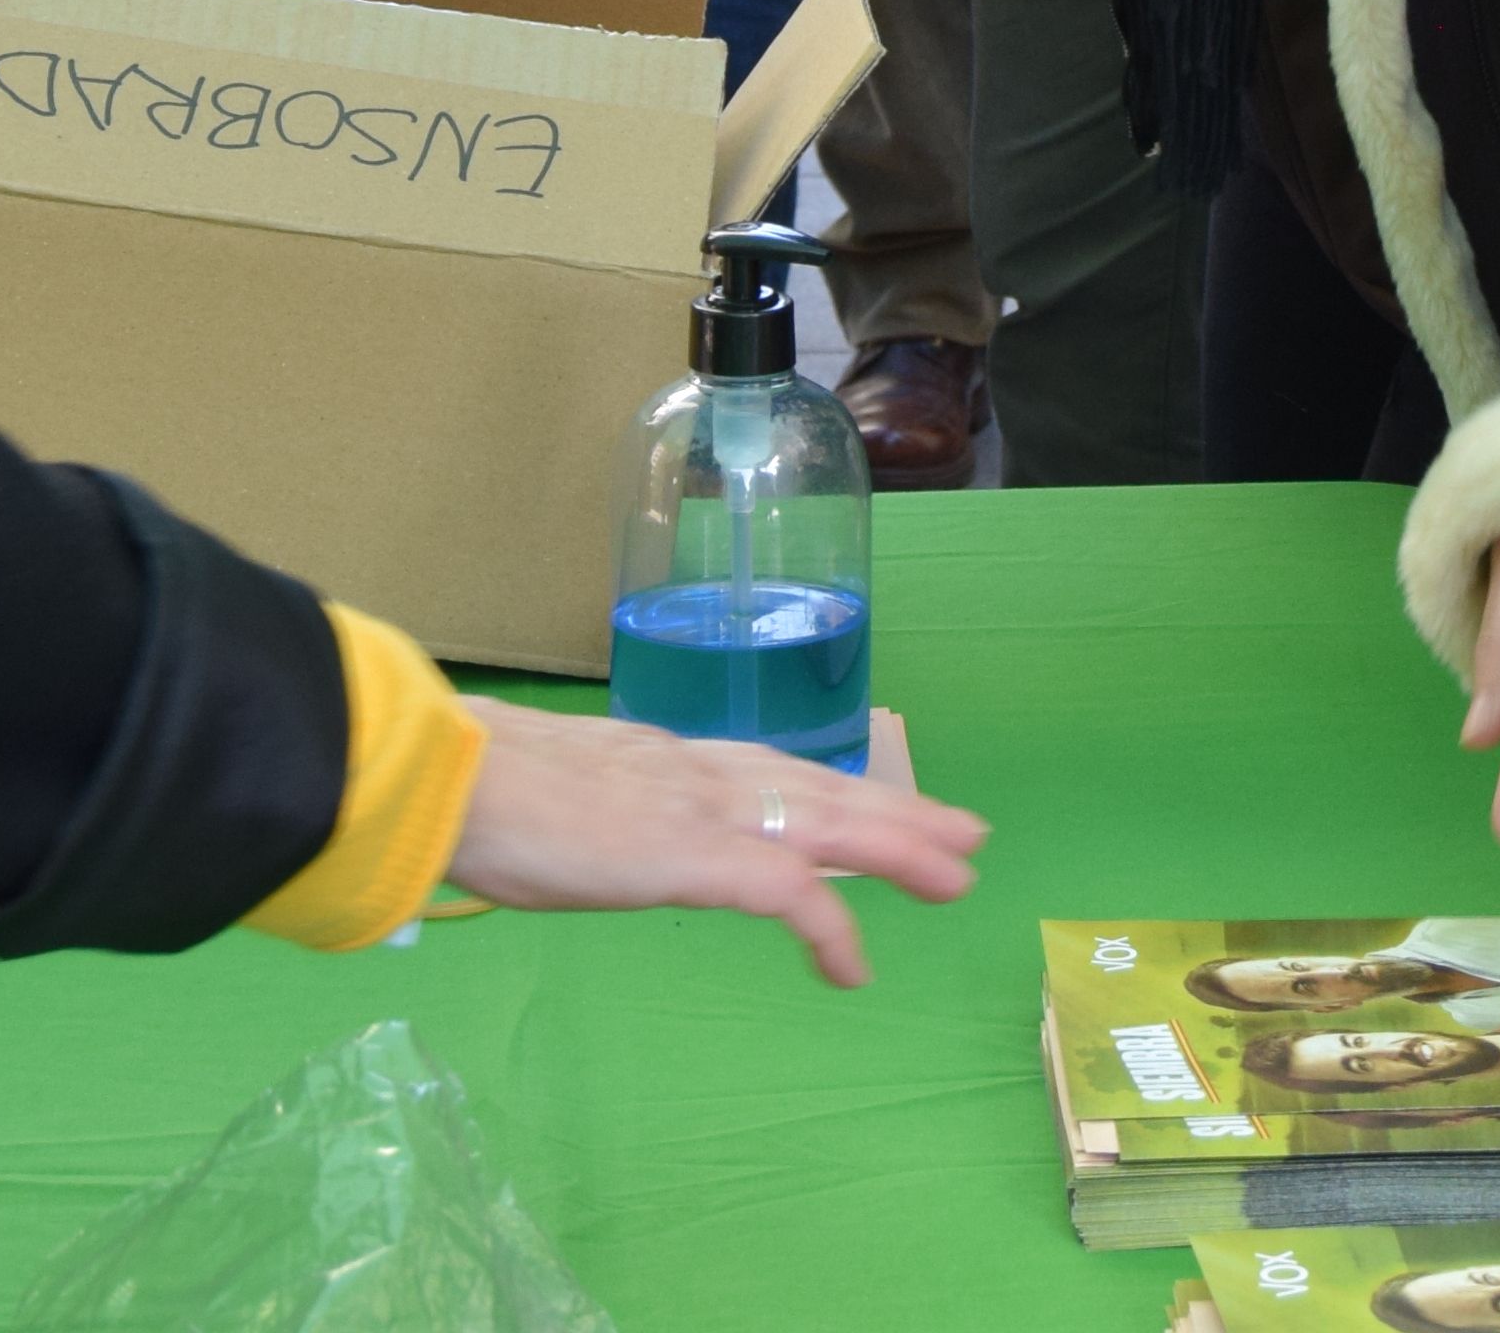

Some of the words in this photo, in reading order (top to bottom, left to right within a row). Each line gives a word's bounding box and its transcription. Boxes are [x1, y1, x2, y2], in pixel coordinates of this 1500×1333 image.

[1090, 935, 1138, 973] VOX
[1109, 1023, 1206, 1102] SIEMBRA
[1254, 1250, 1310, 1298] VOX
